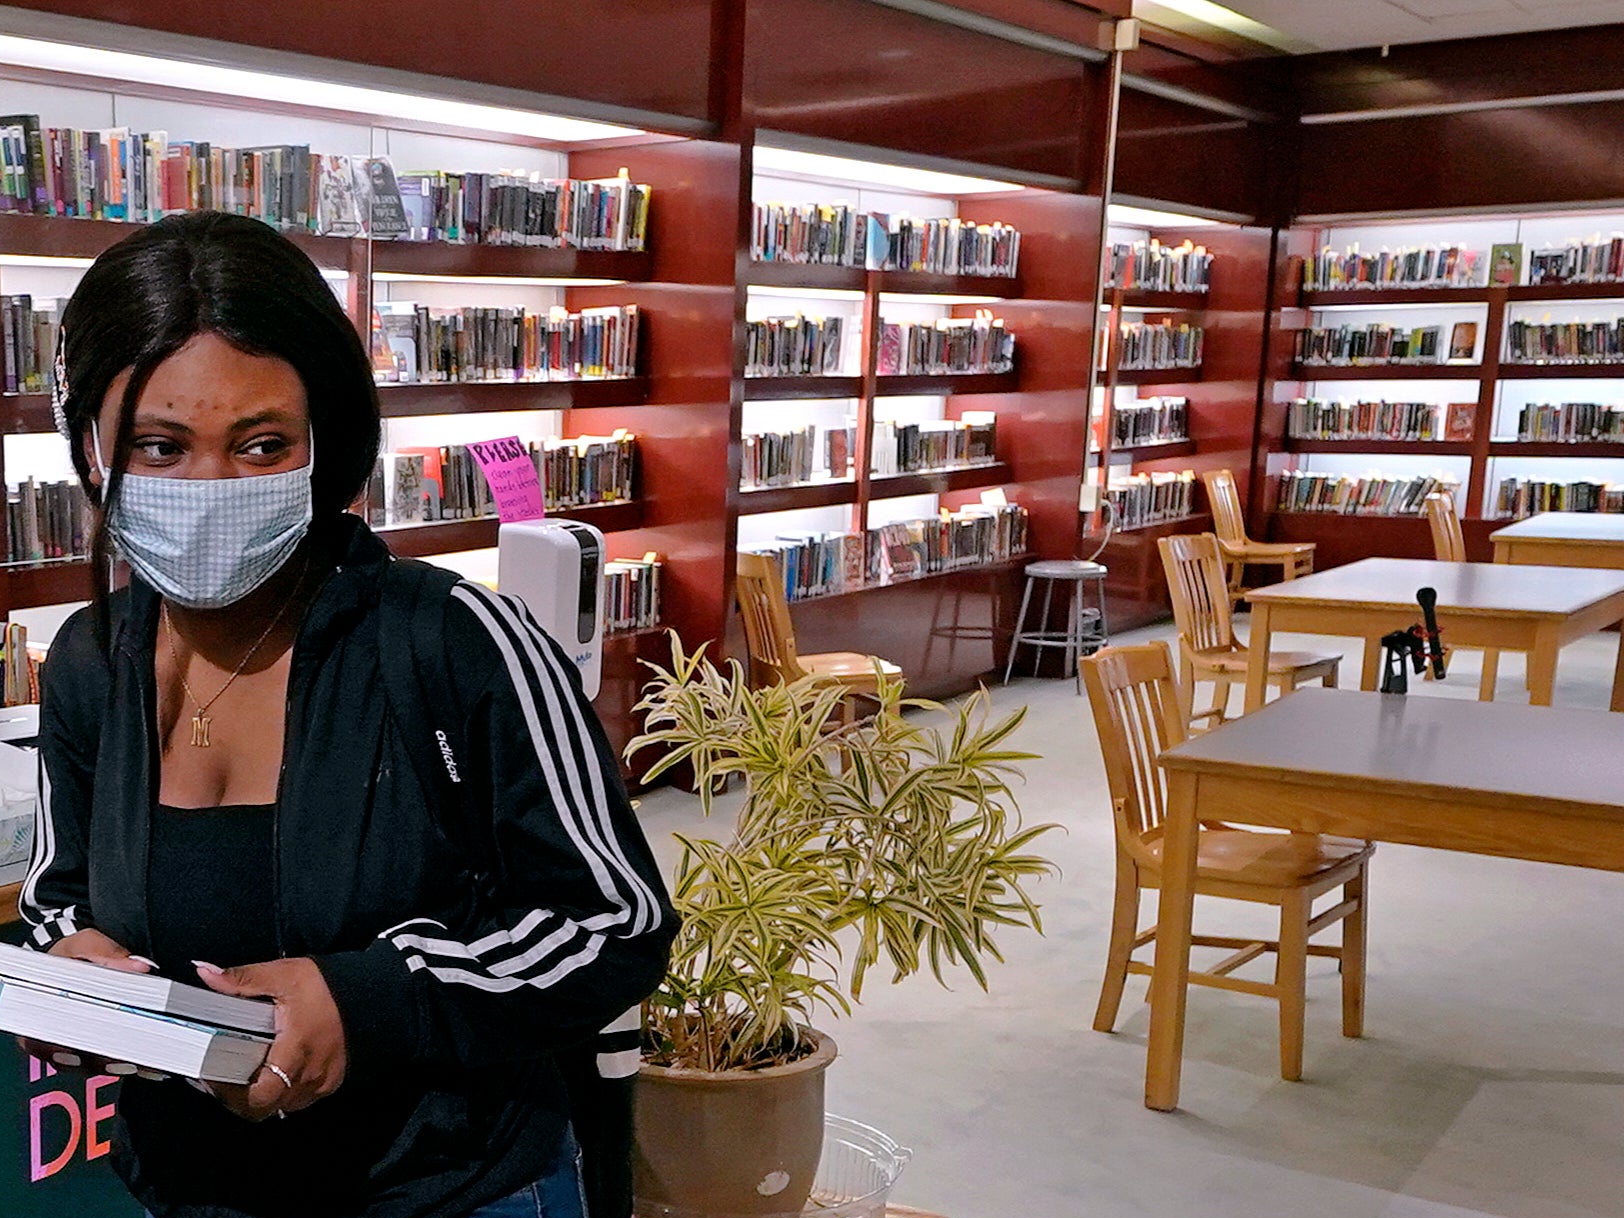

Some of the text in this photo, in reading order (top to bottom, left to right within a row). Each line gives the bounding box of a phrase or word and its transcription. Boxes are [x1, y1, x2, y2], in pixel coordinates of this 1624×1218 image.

[473, 439, 529, 466] PLEASE
[435, 730, 462, 783] adidas
[29, 1074, 121, 1184] DE
